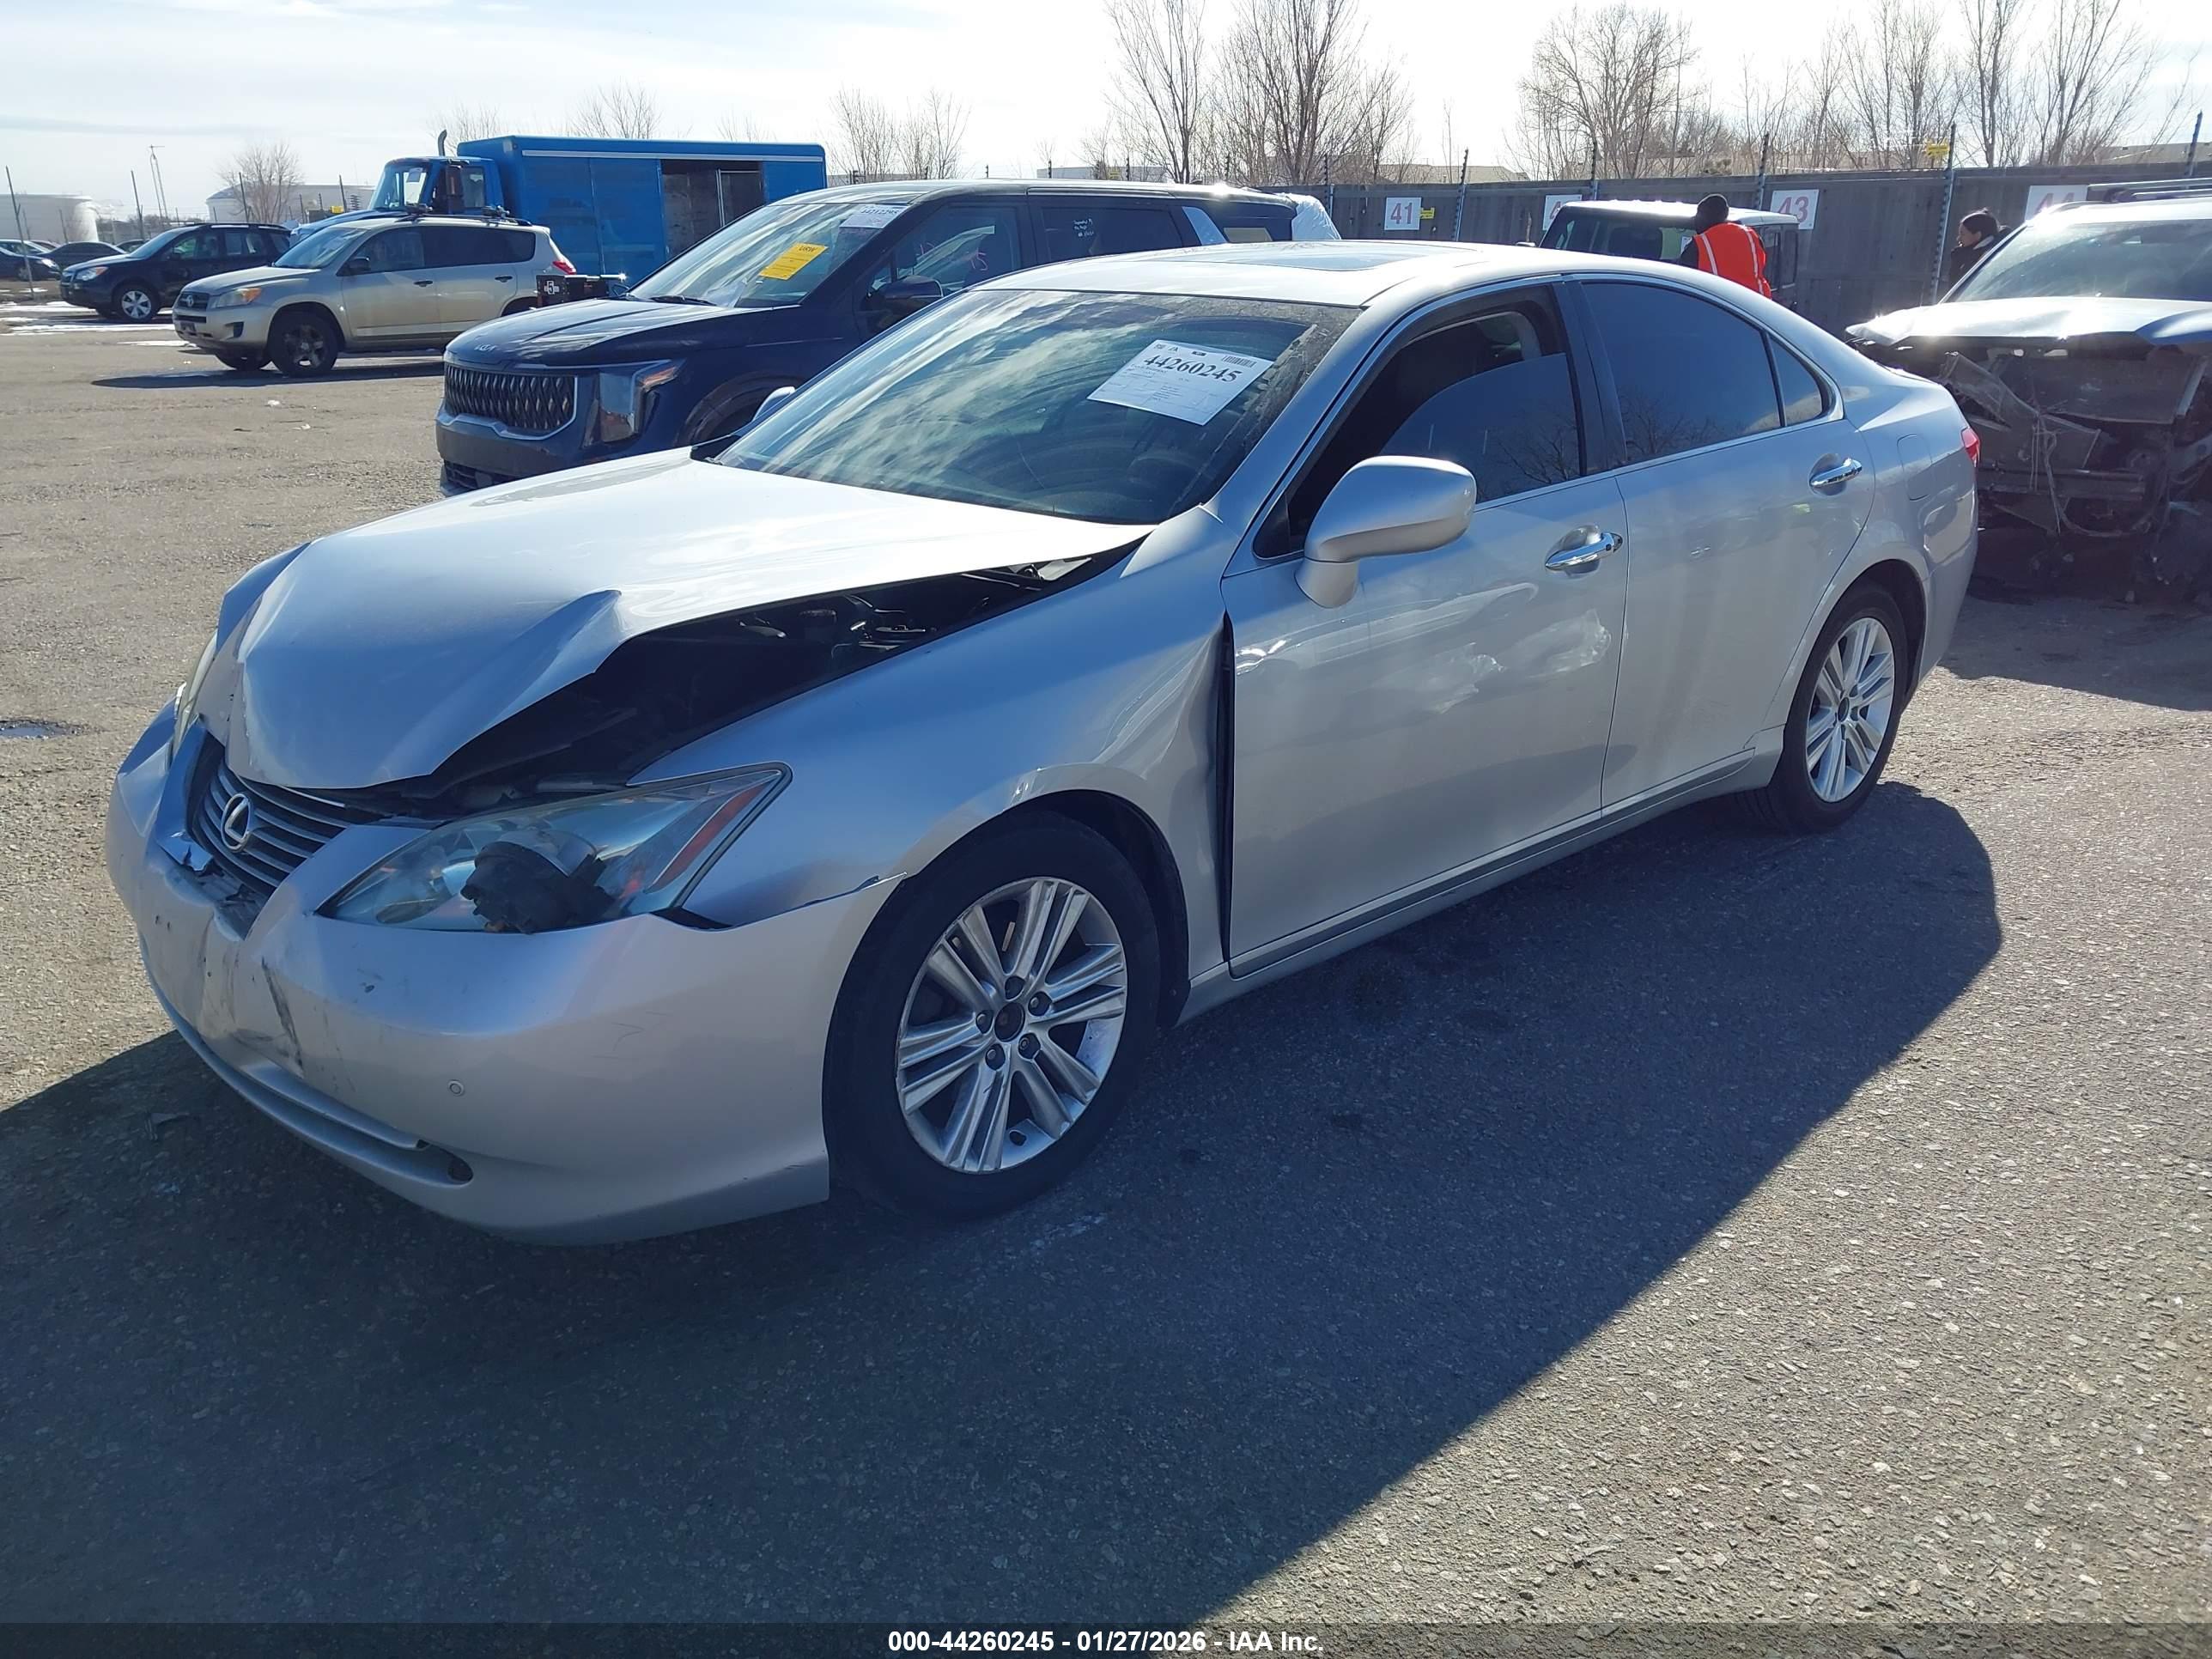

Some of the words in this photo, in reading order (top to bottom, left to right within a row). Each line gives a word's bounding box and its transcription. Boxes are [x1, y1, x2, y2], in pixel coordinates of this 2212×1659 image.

[1390, 202, 1413, 224] 41
[1778, 196, 1809, 223] 43
[1144, 354, 1243, 383] 44260245
